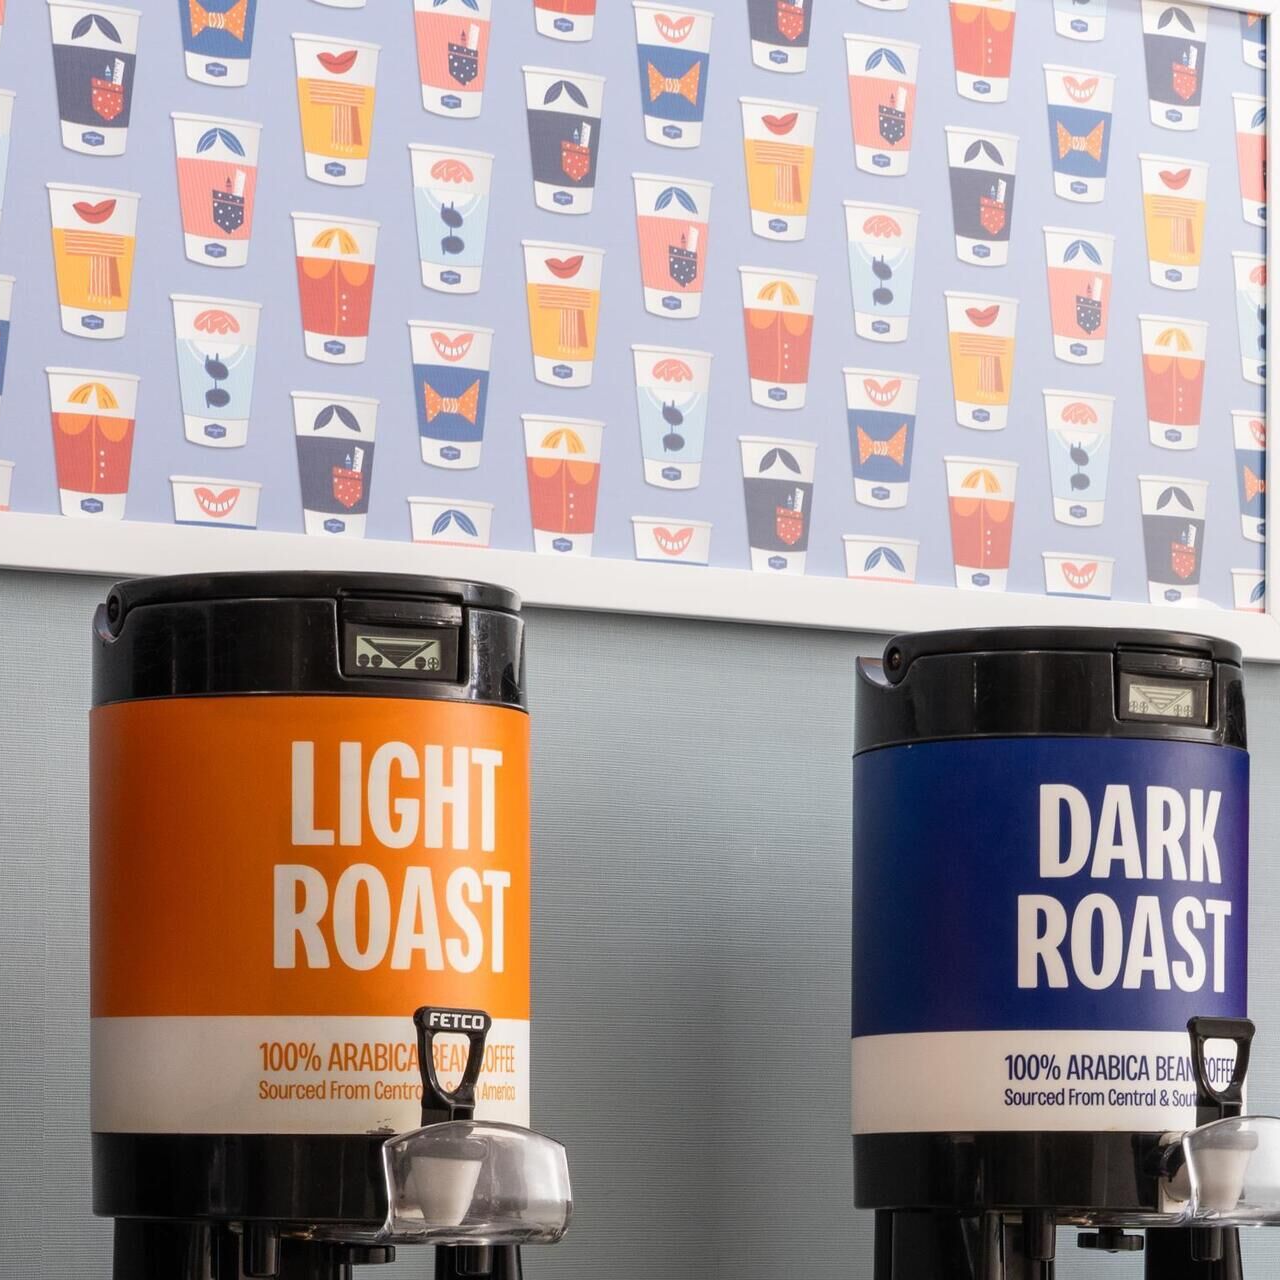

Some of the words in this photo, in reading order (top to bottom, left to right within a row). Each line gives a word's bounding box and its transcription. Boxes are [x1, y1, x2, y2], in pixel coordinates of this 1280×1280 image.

[291, 741, 503, 852] LIGHT
[1039, 783, 1222, 884] DARK
[273, 863, 511, 974] ROAST
[1018, 893, 1232, 993] ROAST
[429, 1012, 485, 1031] FETCO
[259, 1042, 322, 1072] 100%
[328, 1042, 419, 1073] ARABICA
[1005, 1054, 1061, 1081] 100%
[1066, 1054, 1150, 1082] ARABICA
[1156, 1055, 1196, 1083] BEAN
[259, 1080, 326, 1100] Sourced
[330, 1080, 370, 1100] From
[374, 1081, 423, 1101] Centra
[481, 1082, 516, 1101] America
[1004, 1088, 1065, 1107] Sourced
[1070, 1089, 1105, 1107] From
[1108, 1089, 1157, 1107] Central
[1160, 1089, 1170, 1107] &
[1172, 1090, 1197, 1107] Sout
